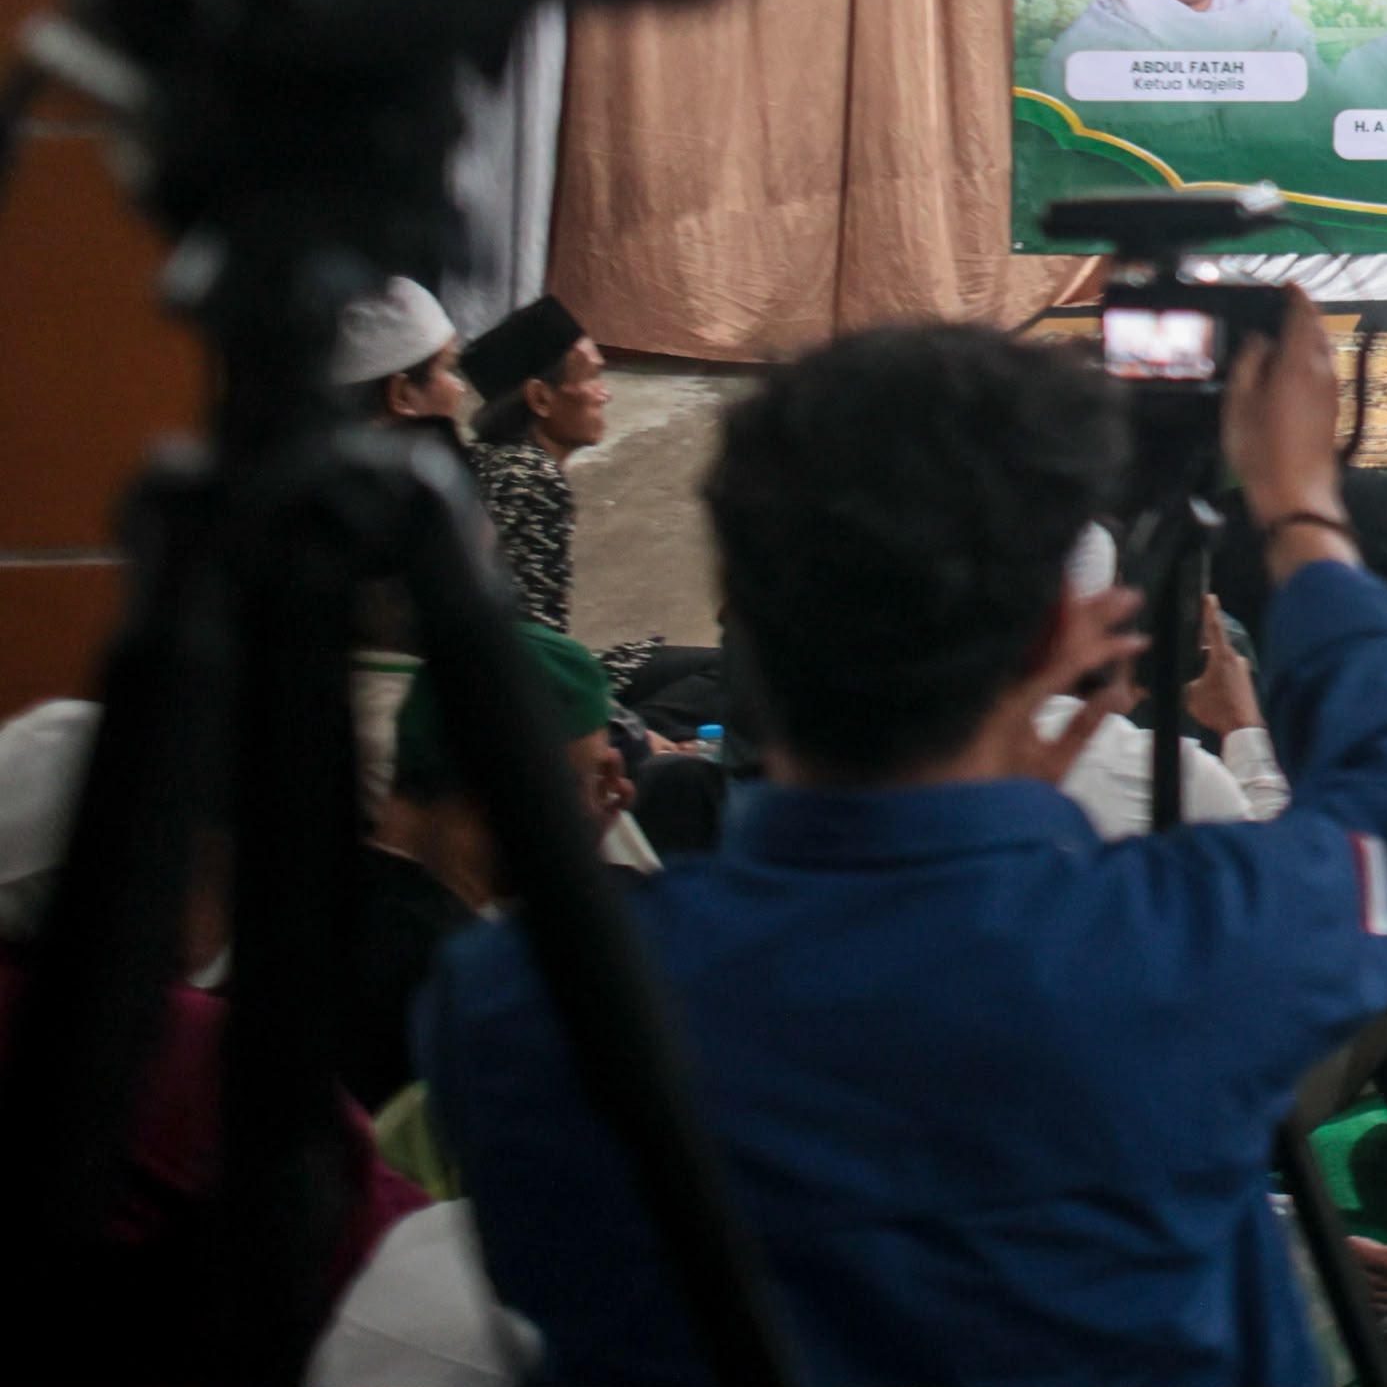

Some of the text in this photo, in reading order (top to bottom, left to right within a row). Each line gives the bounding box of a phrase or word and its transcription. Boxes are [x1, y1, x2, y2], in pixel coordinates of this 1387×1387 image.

[1130, 60, 1245, 74] ABDUL FATAH
[1132, 76, 1246, 94] Ketua Majelis
[1354, 120, 1370, 133] H.
[1373, 120, 1385, 133] A
